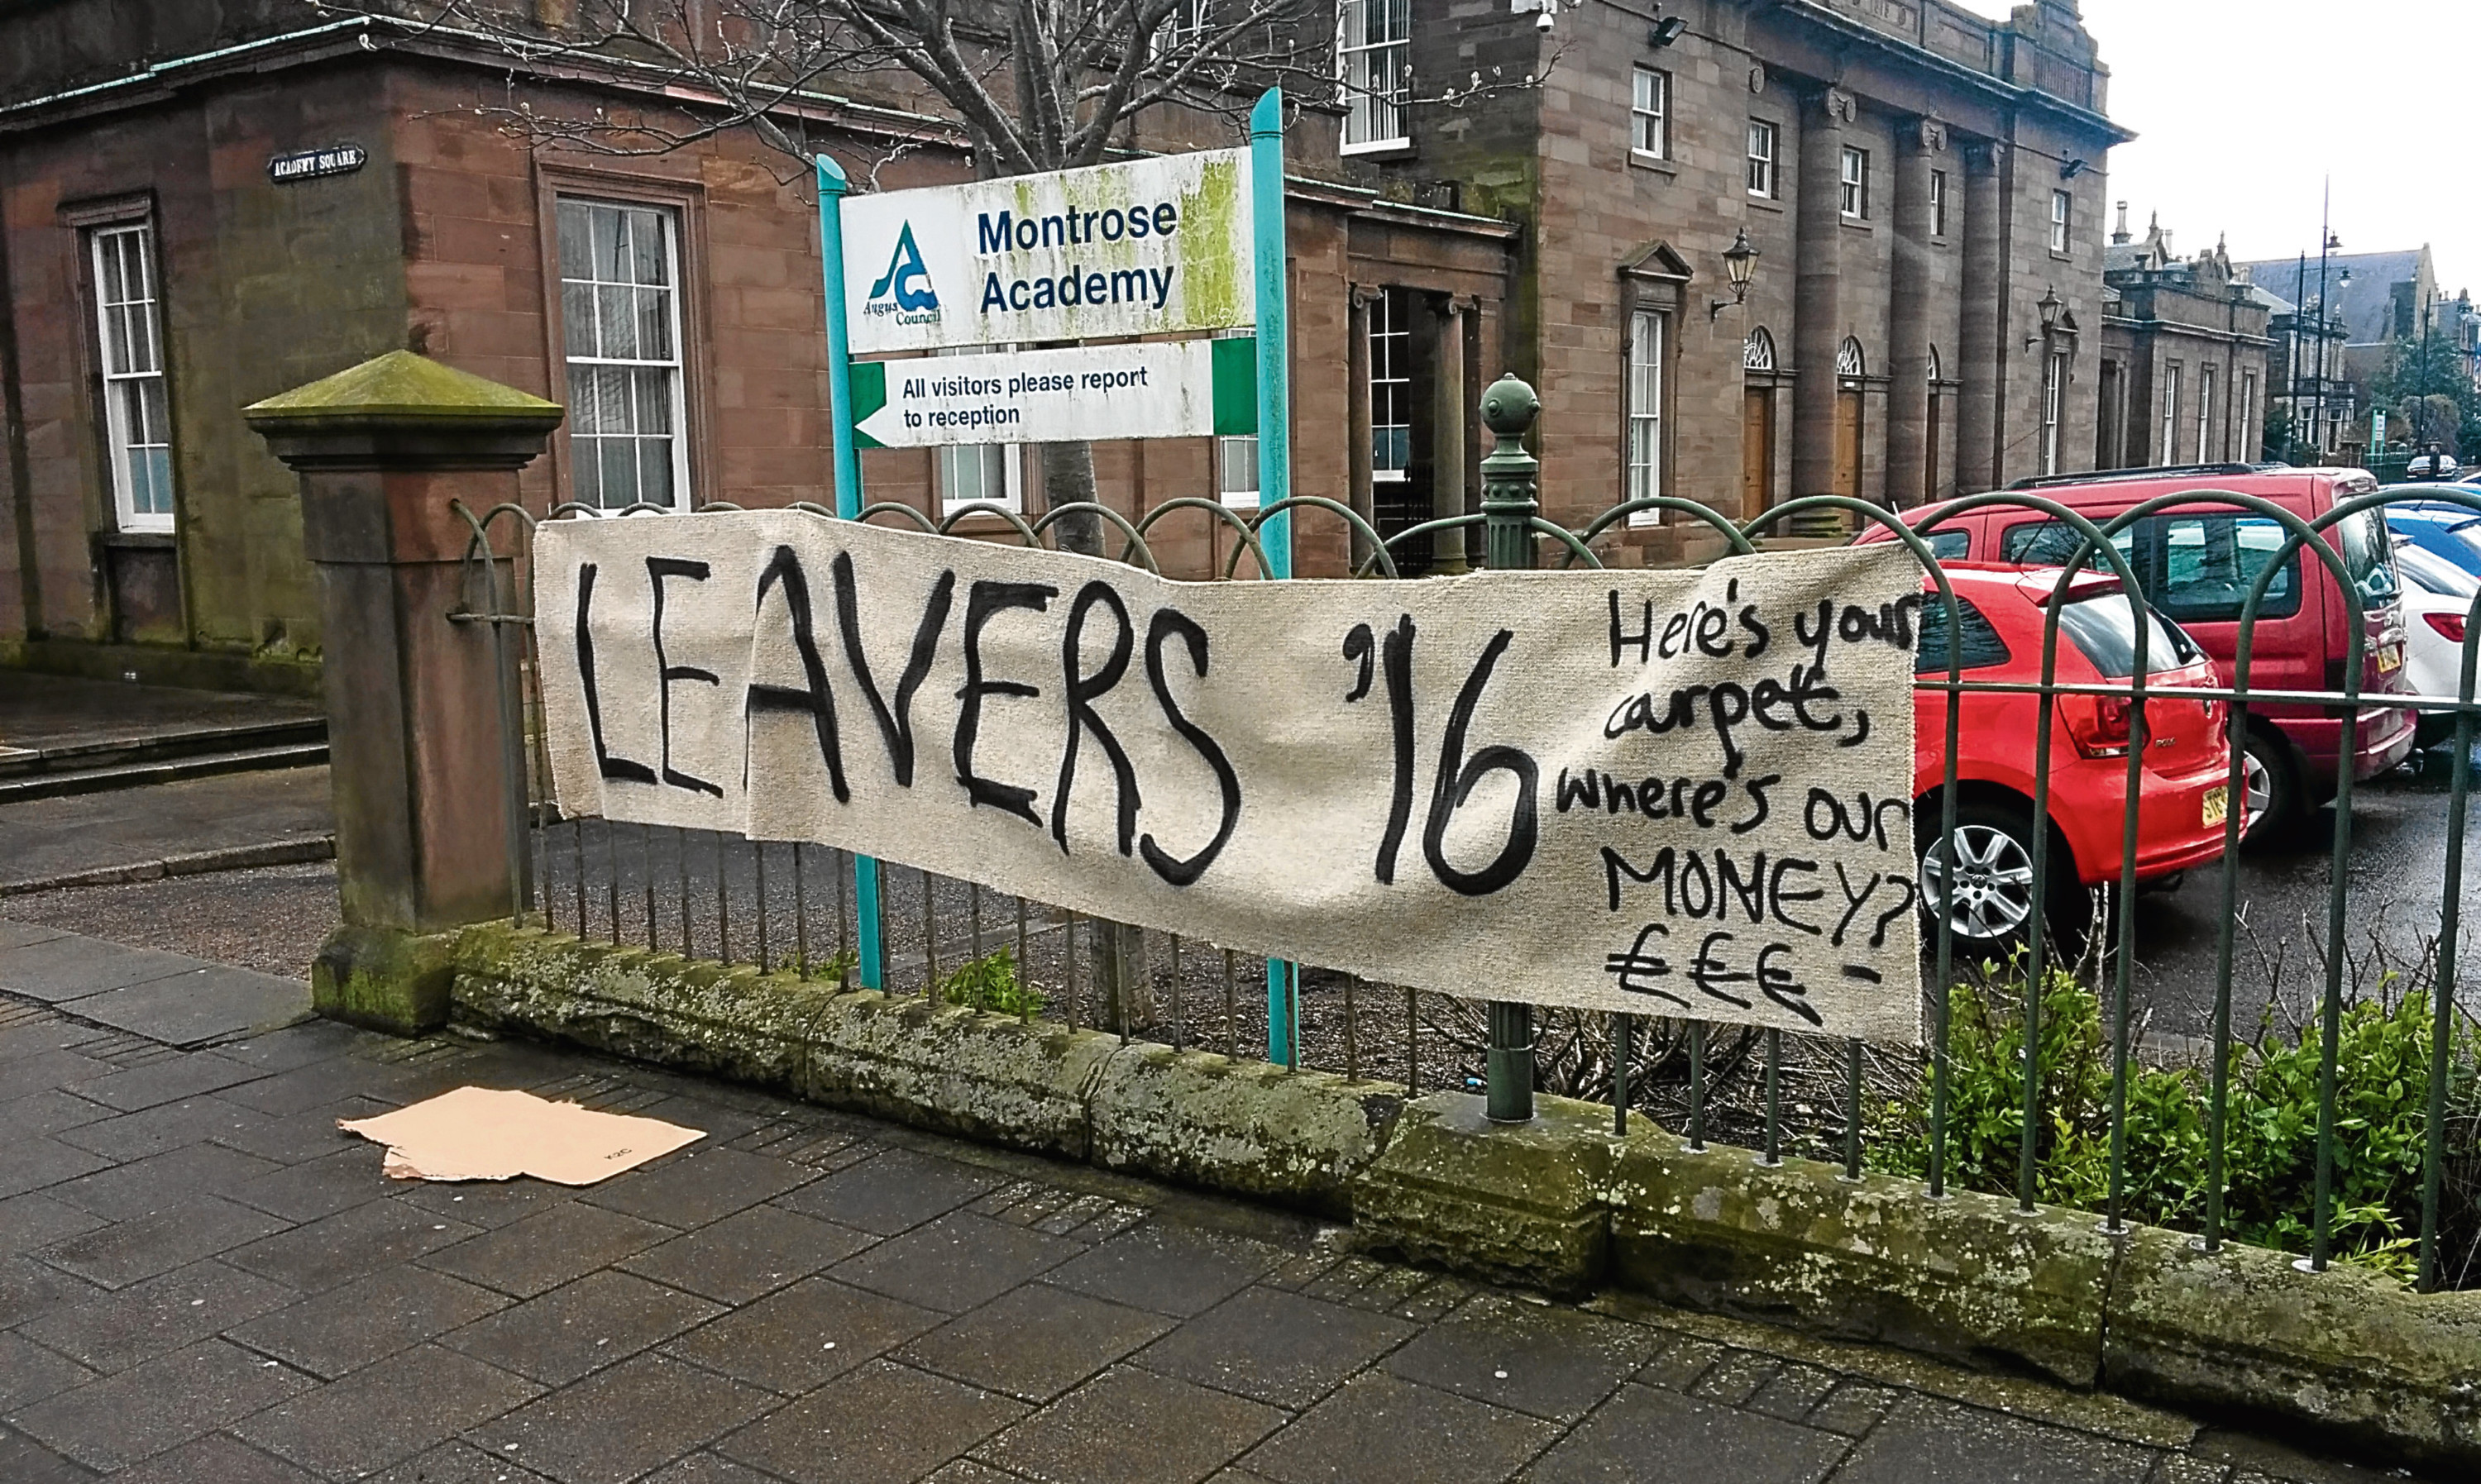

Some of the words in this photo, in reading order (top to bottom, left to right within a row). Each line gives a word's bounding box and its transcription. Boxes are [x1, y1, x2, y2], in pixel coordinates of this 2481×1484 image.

[275, 156, 316, 177] ACADEMY
[319, 150, 356, 169] SQUARE
[978, 202, 1178, 255] Montrose
[863, 301, 899, 317] Angus
[979, 264, 1174, 314] Academy
[896, 309, 941, 326] Council
[903, 378, 926, 399] All
[931, 375, 1002, 397] visitors
[1008, 372, 1074, 398] please
[1081, 366, 1149, 393] report
[904, 409, 922, 427] to
[928, 404, 1021, 430] reception
[1609, 578, 1770, 668] Here's
[1795, 594, 1922, 680] your
[576, 544, 1241, 886] LEAVERS
[1342, 613, 1540, 896] '16
[1556, 767, 1781, 834] where's
[1805, 786, 1910, 852] our
[1601, 846, 1919, 947] MONEY?
